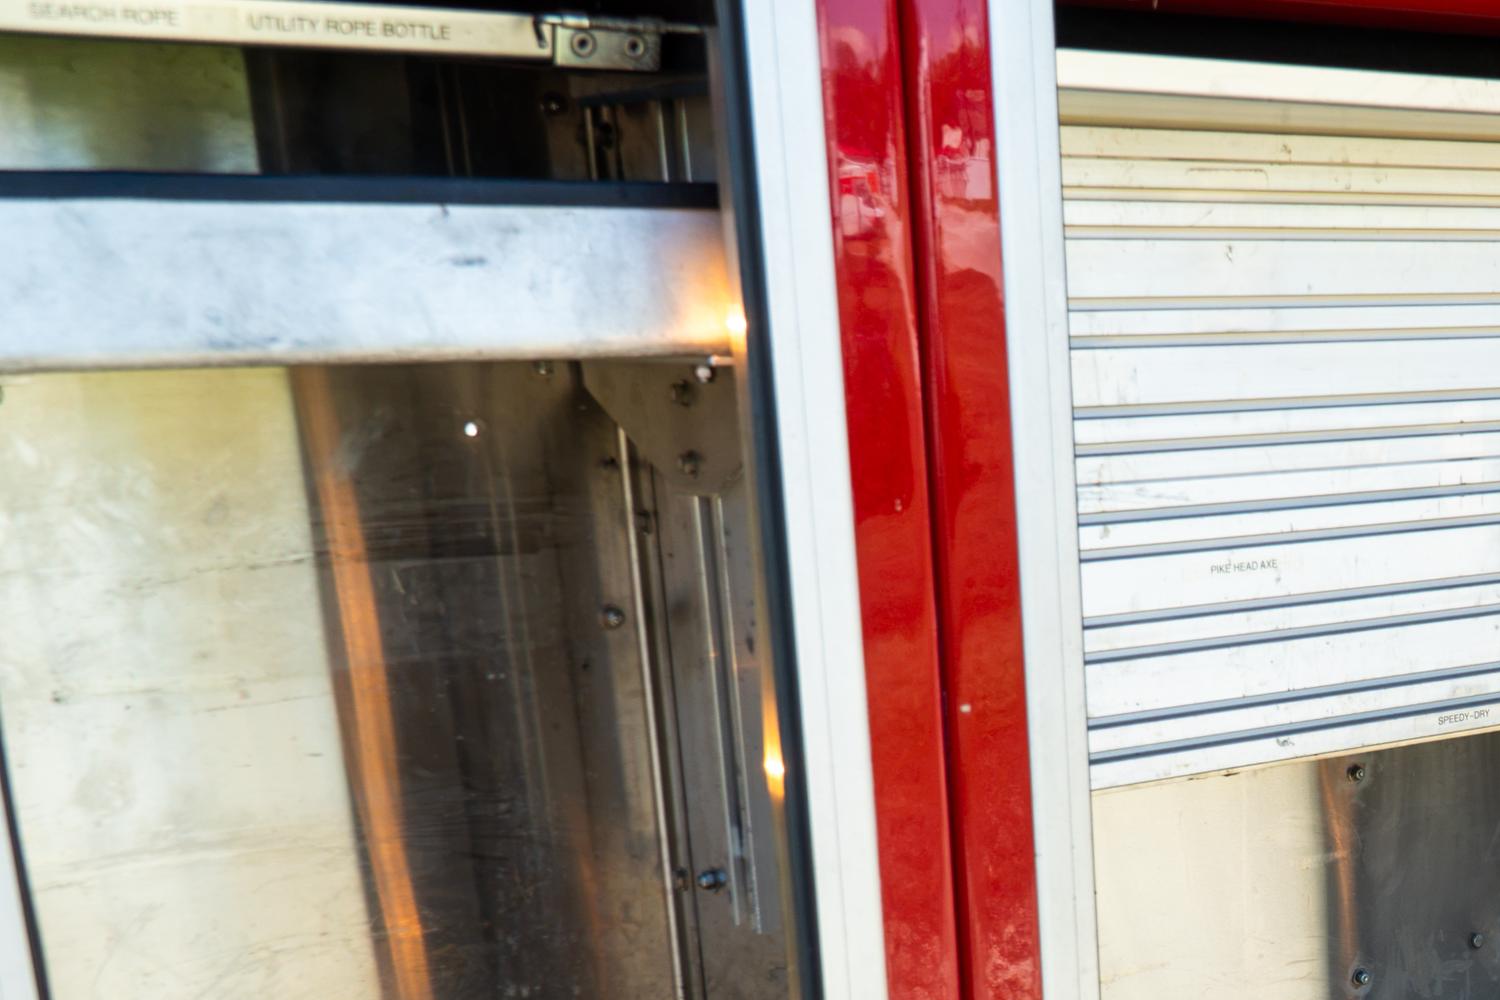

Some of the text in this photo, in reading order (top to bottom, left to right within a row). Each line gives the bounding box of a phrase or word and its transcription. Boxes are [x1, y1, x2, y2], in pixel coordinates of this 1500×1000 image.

[30, 3, 180, 26] SEARCH ROPE
[249, 14, 451, 40] UTILITY ROPE BOTTLE
[1210, 558, 1278, 575] PIKE HEAD AXE
[1437, 708, 1490, 726] SPEEDY-DRY
